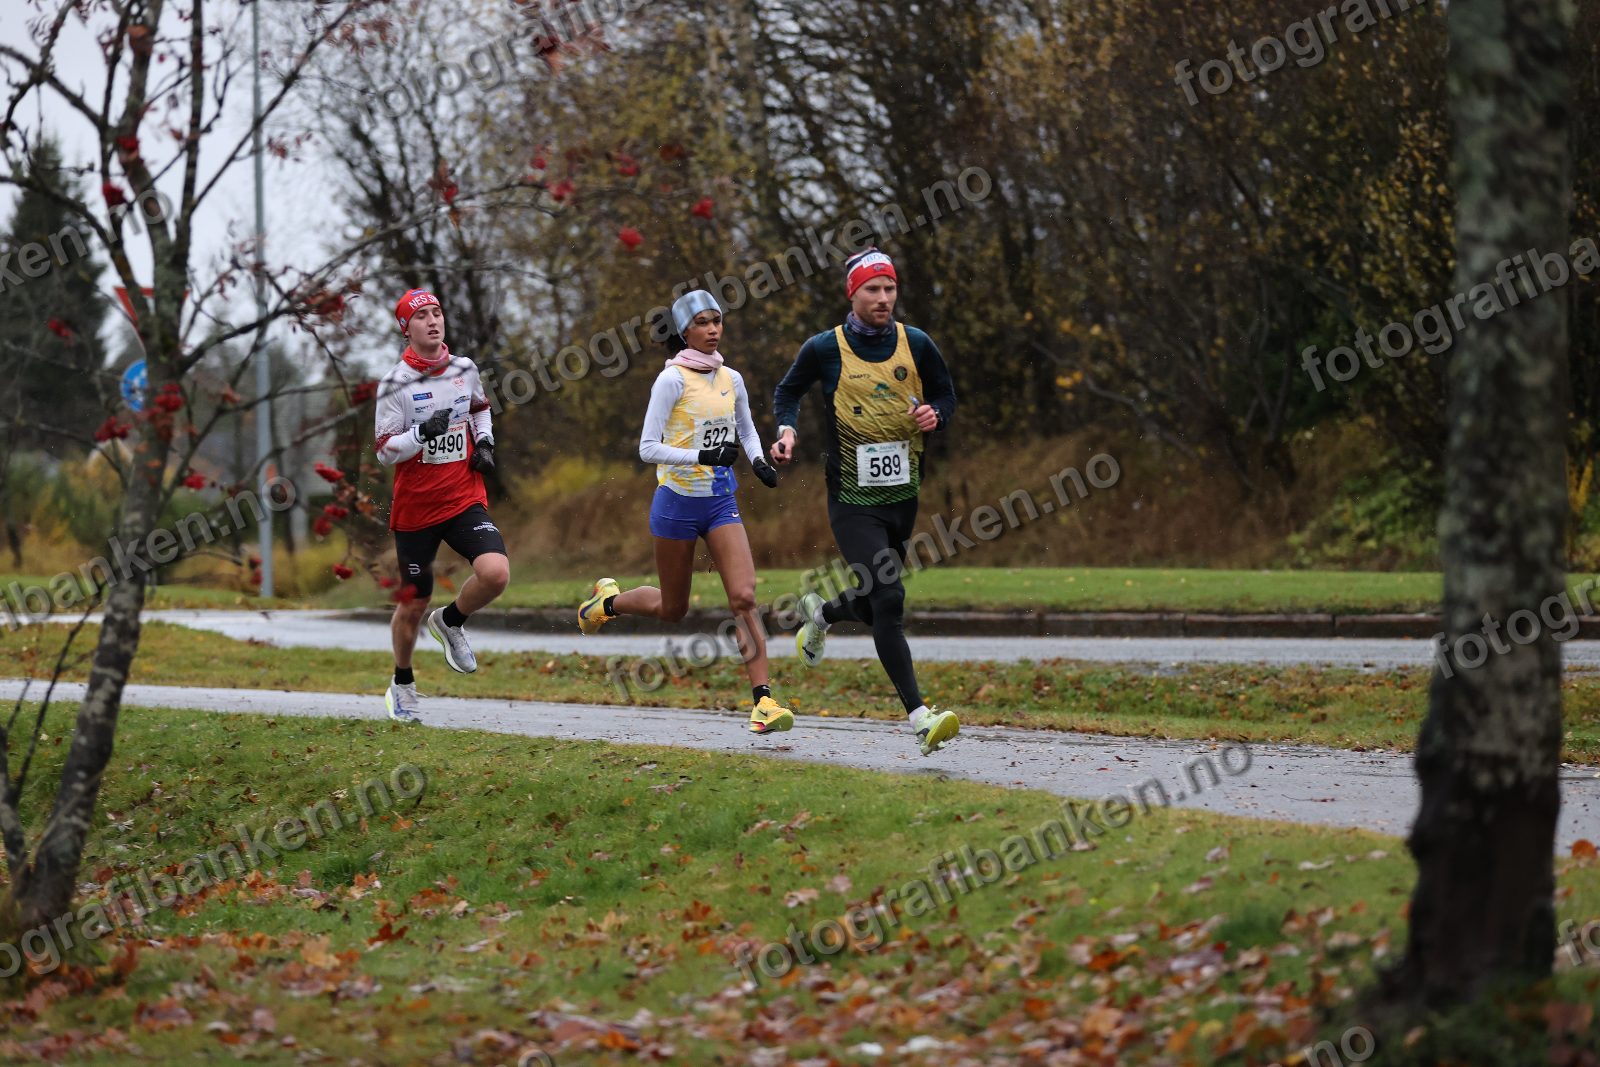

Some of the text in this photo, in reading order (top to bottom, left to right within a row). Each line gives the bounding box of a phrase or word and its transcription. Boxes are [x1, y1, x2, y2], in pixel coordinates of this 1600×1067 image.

[408, 294, 428, 310] NES
[427, 433, 464, 456] 9490
[702, 426, 729, 448] 522
[869, 454, 902, 478] 589
